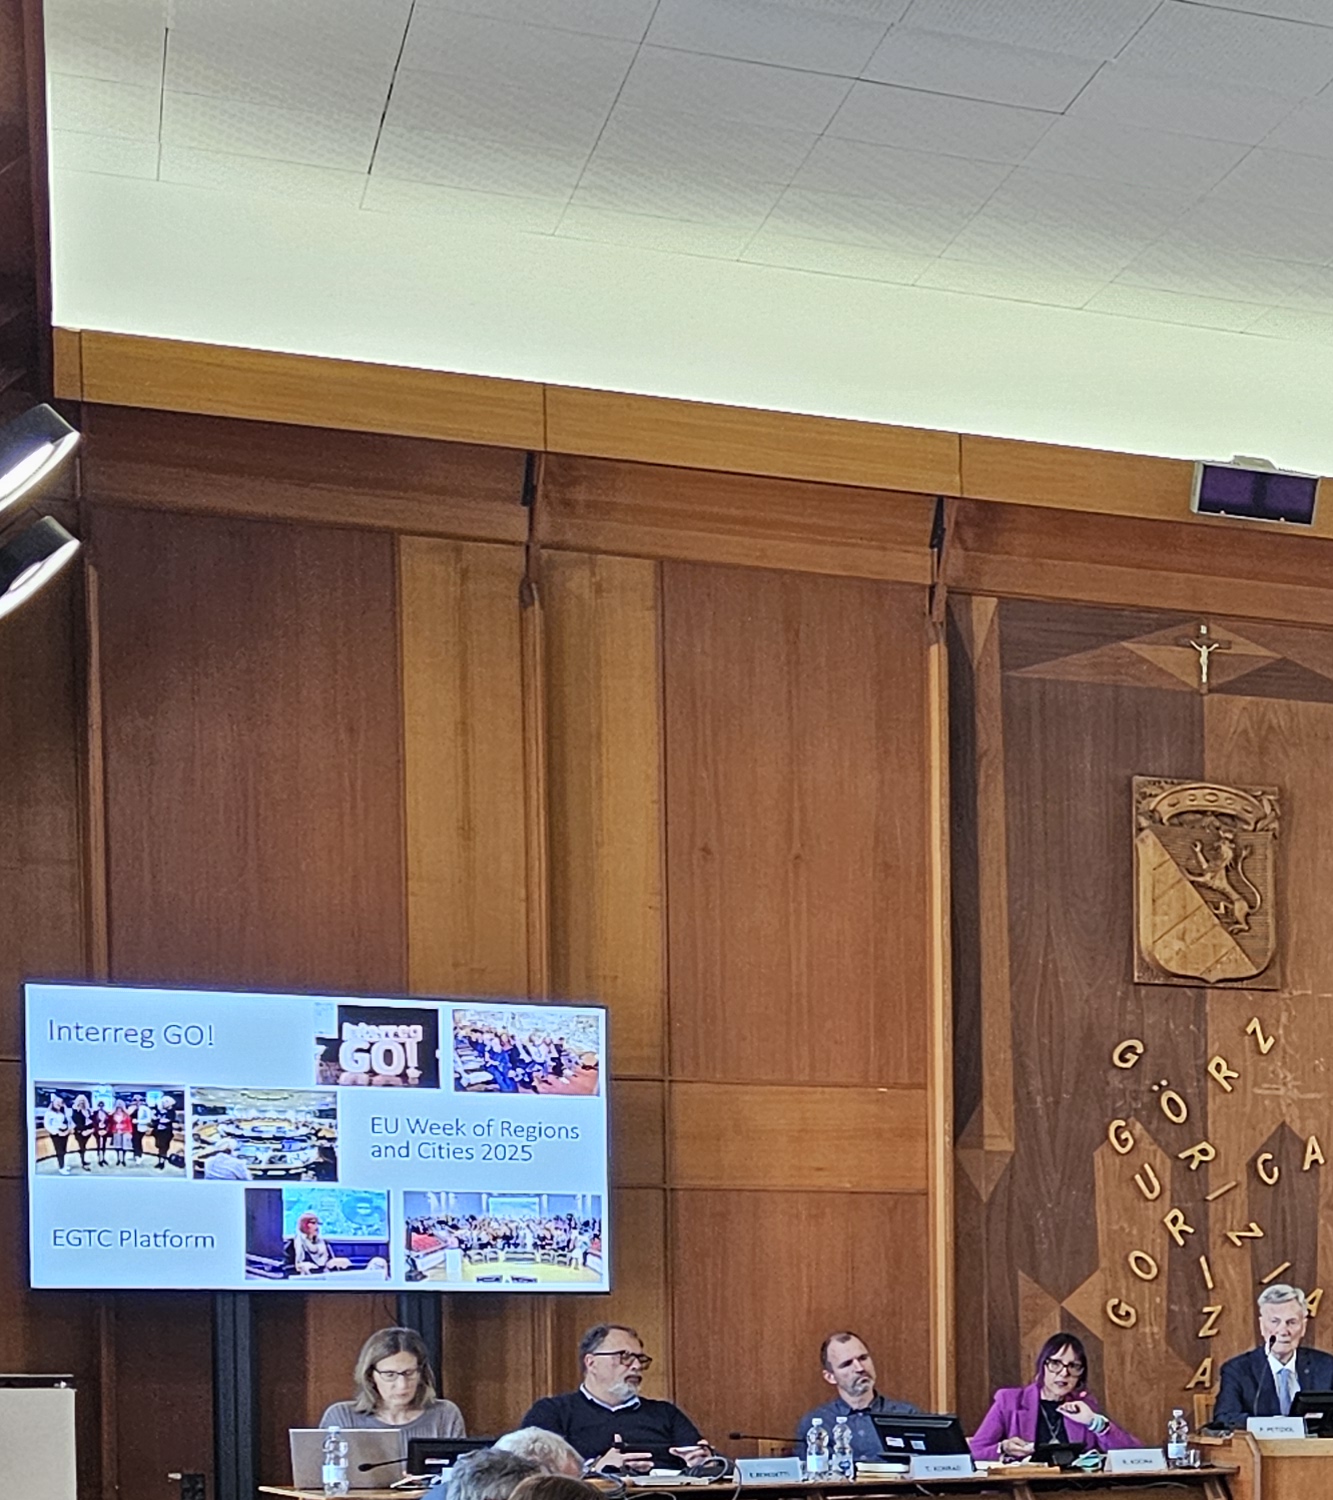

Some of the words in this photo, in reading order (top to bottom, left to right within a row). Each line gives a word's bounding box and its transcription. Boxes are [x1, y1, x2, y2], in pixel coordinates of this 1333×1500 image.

[48, 1019, 154, 1050] Interreg
[164, 1025, 215, 1047] GO!
[339, 1040, 422, 1078] GO!
[370, 1116, 400, 1136] EU
[406, 1116, 468, 1137] Week
[472, 1118, 494, 1138] of
[500, 1120, 580, 1144] Regions
[370, 1141, 410, 1160] and
[416, 1141, 474, 1162] Cities
[480, 1143, 533, 1162] 2025
[52, 1228, 112, 1248] EGTC
[120, 1228, 216, 1250] Platform
